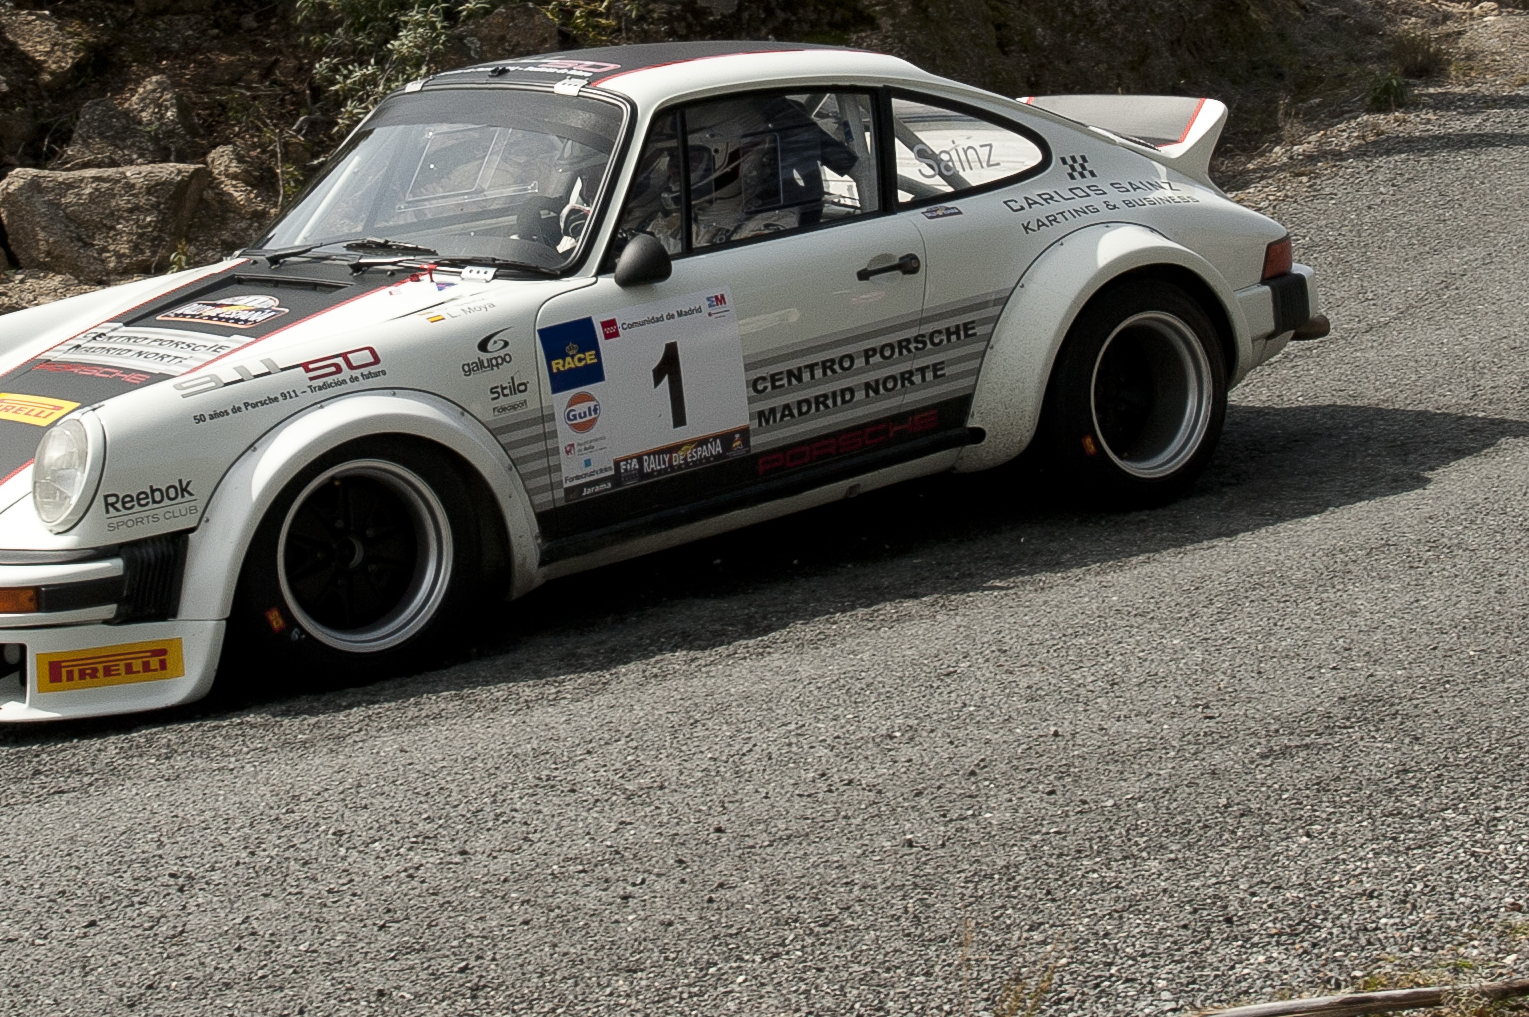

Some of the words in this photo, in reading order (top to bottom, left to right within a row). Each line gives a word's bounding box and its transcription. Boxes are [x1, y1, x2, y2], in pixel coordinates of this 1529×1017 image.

[912, 139, 1001, 179] Sainz
[1003, 184, 1108, 213] CARLOS
[1110, 180, 1182, 194] SAINZ
[1021, 203, 1101, 235] KARTING
[1106, 199, 1120, 211] &
[1124, 194, 1200, 209] BUSINESS
[461, 302, 496, 316] Moya
[621, 314, 665, 331] Comunidad
[666, 312, 675, 321] de
[677, 306, 703, 318] Madrid
[66, 343, 131, 355] MADRID
[82, 331, 149, 344] CENTRO
[32, 363, 151, 384] PORSCHE
[173, 358, 281, 399] 911
[301, 345, 381, 381] 50
[462, 353, 512, 376] galuppo
[551, 350, 598, 373] RACE
[751, 353, 855, 395] CENTRO
[863, 320, 978, 366] PORSCHE
[193, 413, 207, 424] 50
[209, 407, 230, 421] años
[231, 404, 242, 414] de
[244, 395, 279, 411] Porsche
[280, 390, 299, 401] 911
[308, 378, 348, 394] Tradición
[349, 375, 360, 384] de
[360, 368, 387, 382] futuro
[490, 376, 528, 401] Stilo
[652, 341, 687, 429] 1
[757, 385, 856, 428] MADRID
[864, 361, 946, 399] NORTE
[566, 404, 599, 422] Gulf
[643, 453, 670, 473] RALLY
[672, 453, 685, 466] DE
[687, 438, 723, 462] ESPAÑA
[758, 409, 939, 475] PORSCHE
[103, 478, 195, 514] Reebok
[582, 482, 612, 496] Jarama
[107, 514, 160, 532] SPORTS
[164, 506, 199, 521] CLUB
[48, 648, 168, 683] PIRELLI
